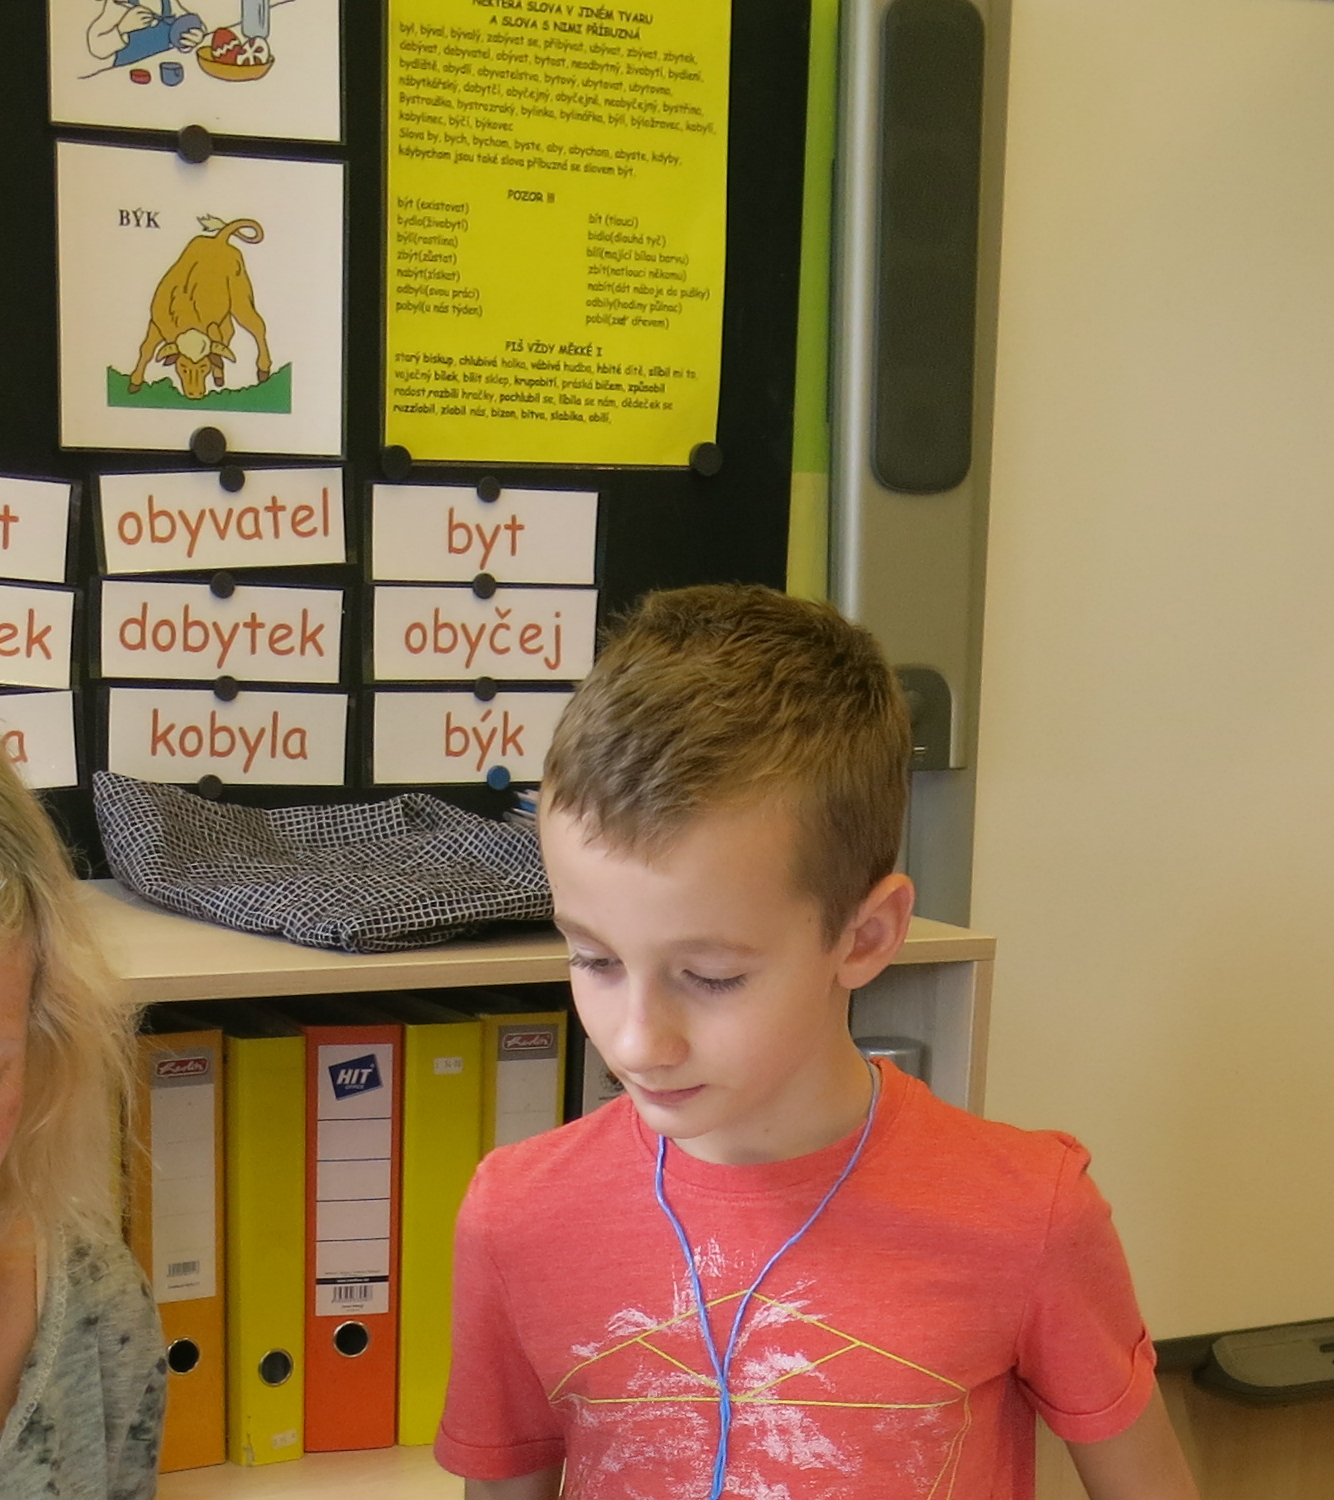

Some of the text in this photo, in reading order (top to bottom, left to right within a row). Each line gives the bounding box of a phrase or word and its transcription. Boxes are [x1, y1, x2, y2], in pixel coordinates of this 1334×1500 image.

[489, 15, 497, 24] A
[502, 17, 537, 28] SLOVA
[542, 22, 549, 30] S
[554, 22, 581, 34] NIMI
[527, 1, 562, 14] SLOVA
[567, 5, 573, 15] V
[579, 5, 613, 19] JINÉM
[619, 11, 653, 24] TVARU
[508, 190, 543, 202] POZOR
[118, 208, 159, 230] BÝK
[505, 339, 602, 356] PIŠ VŽDY MĚKKÉ I
[118, 487, 330, 558] obyvatel
[447, 508, 524, 570] byt
[119, 603, 324, 666] dobytek
[404, 609, 562, 669] obyčej
[150, 708, 308, 774] kobyla
[445, 710, 524, 772] býk
[337, 1069, 373, 1085] HIT
